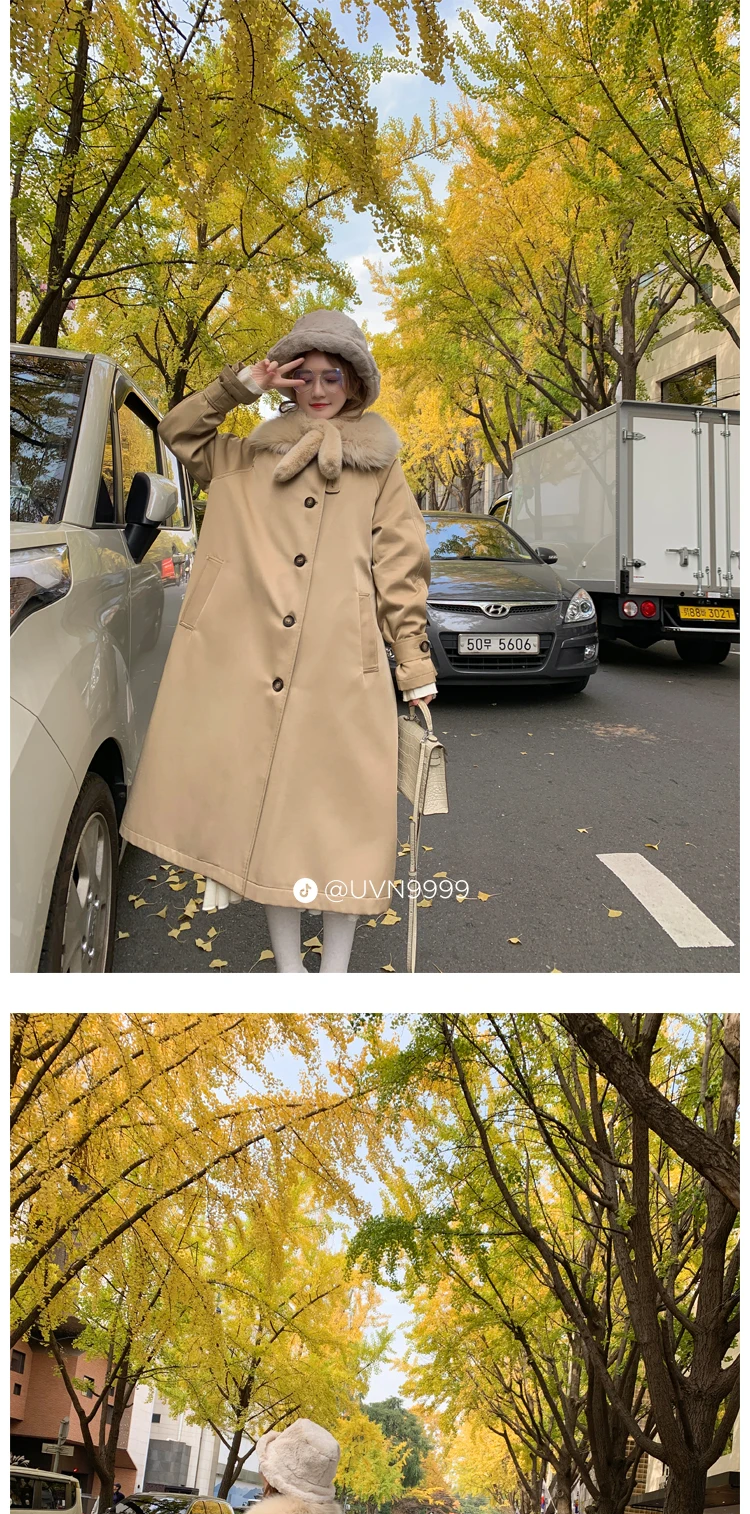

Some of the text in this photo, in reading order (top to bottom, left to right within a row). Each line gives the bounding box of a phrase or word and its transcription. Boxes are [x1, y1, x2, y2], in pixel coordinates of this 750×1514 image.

[708, 609, 731, 618] 3021
[467, 638, 531, 651] 50무 5606
